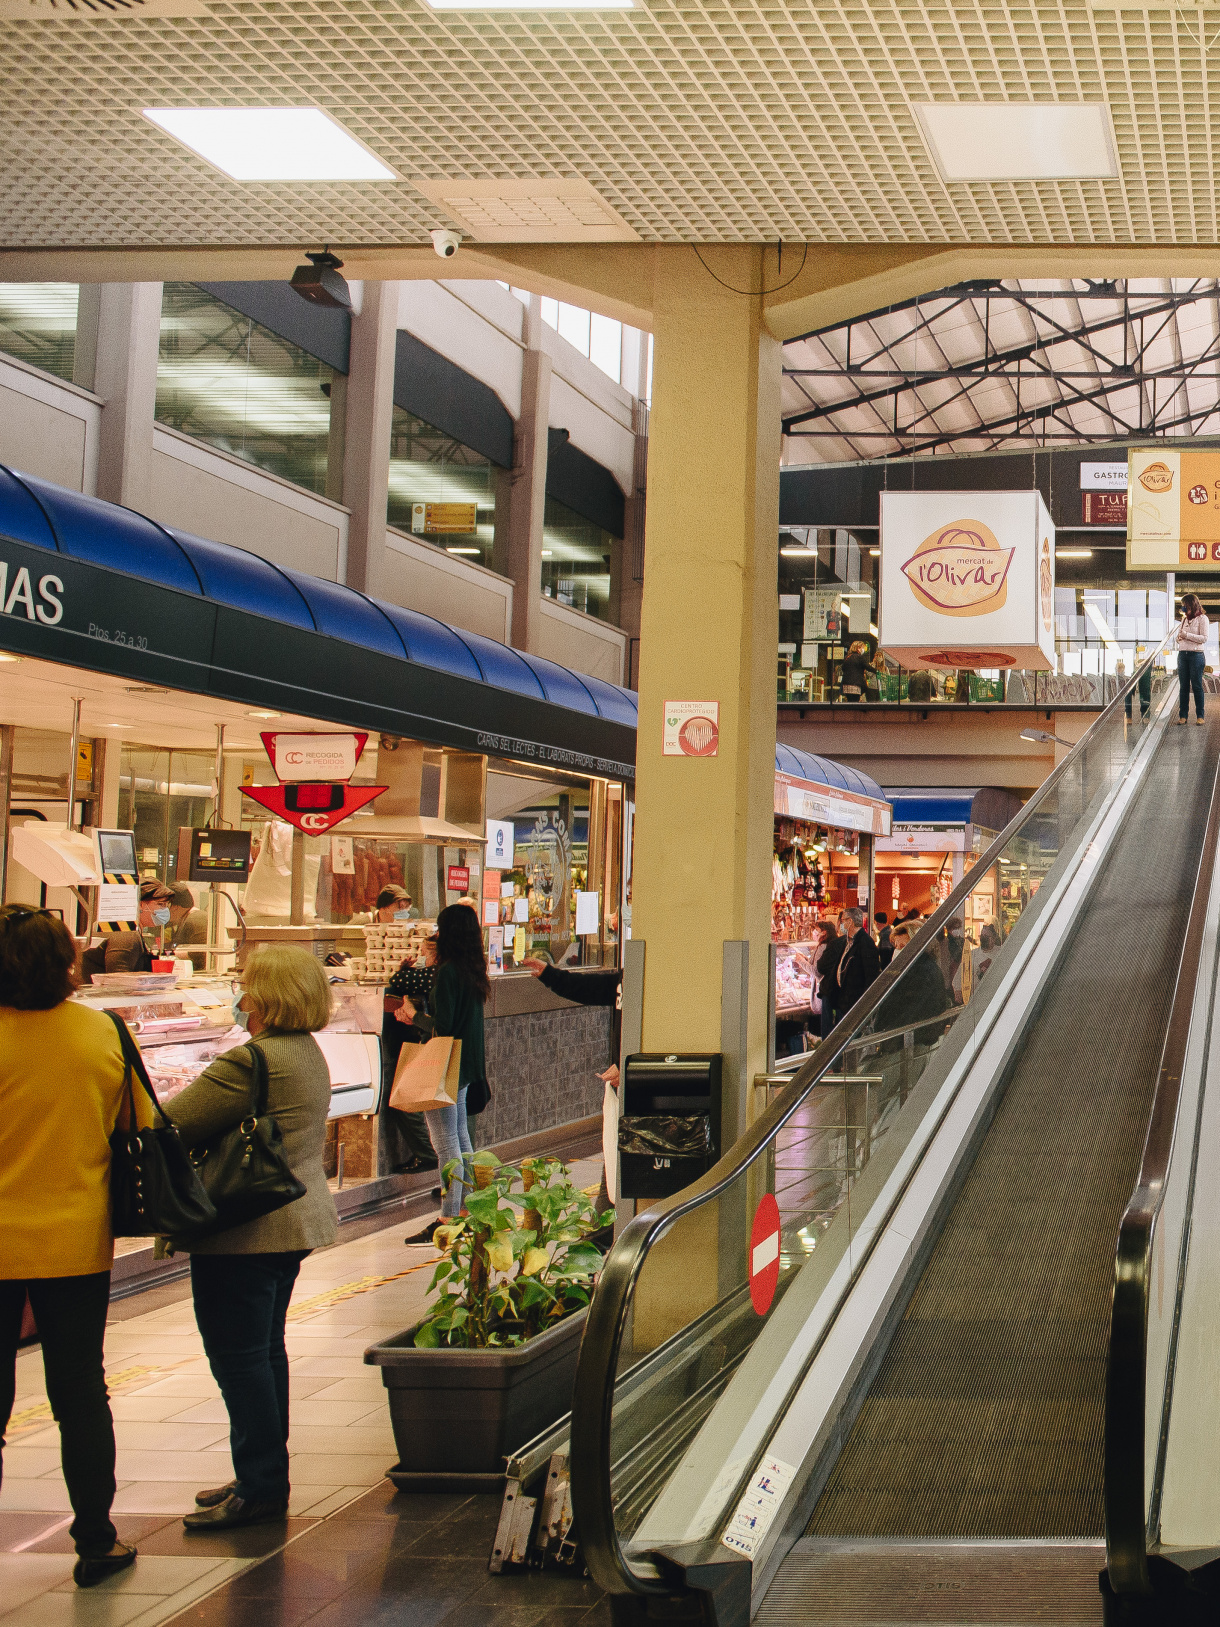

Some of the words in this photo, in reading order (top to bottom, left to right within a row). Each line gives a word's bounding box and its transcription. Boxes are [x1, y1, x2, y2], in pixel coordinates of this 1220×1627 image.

[1214, 492, 1217, 500] i
[956, 557, 986, 565] mercat
[919, 562, 1001, 586] l'Olivar
[88, 622, 111, 641] Ptos.
[114, 630, 127, 646] 25
[128, 636, 134, 647] a
[136, 636, 148, 651] 30
[477, 733, 499, 749] CARNS
[574, 754, 594, 769] PROPIS
[725, 1536, 752, 1553] OTIS
